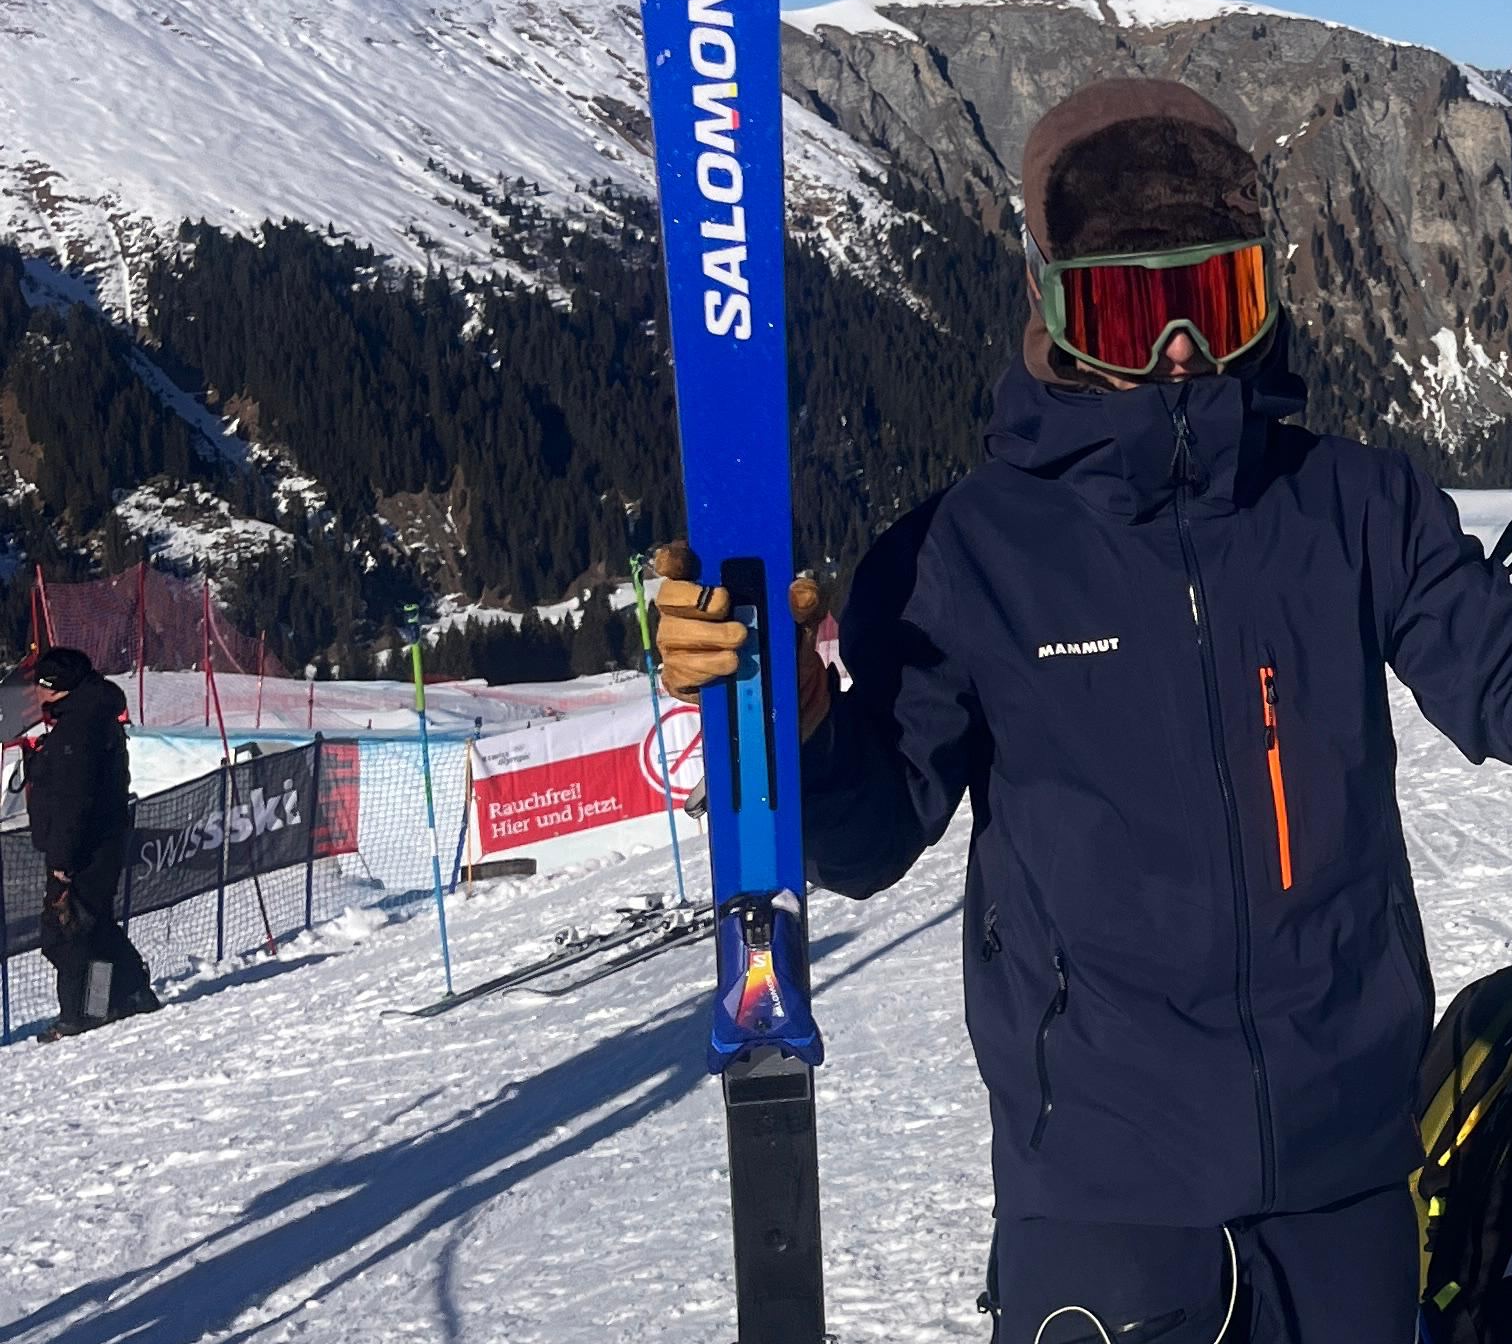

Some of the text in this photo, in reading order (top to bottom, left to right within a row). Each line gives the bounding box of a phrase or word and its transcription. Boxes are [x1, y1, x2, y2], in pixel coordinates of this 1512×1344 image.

[1038, 637, 1119, 658] MAMMUT
[489, 782, 582, 820] Rauchfrei!
[491, 795, 623, 839] Hier und jetzt.
